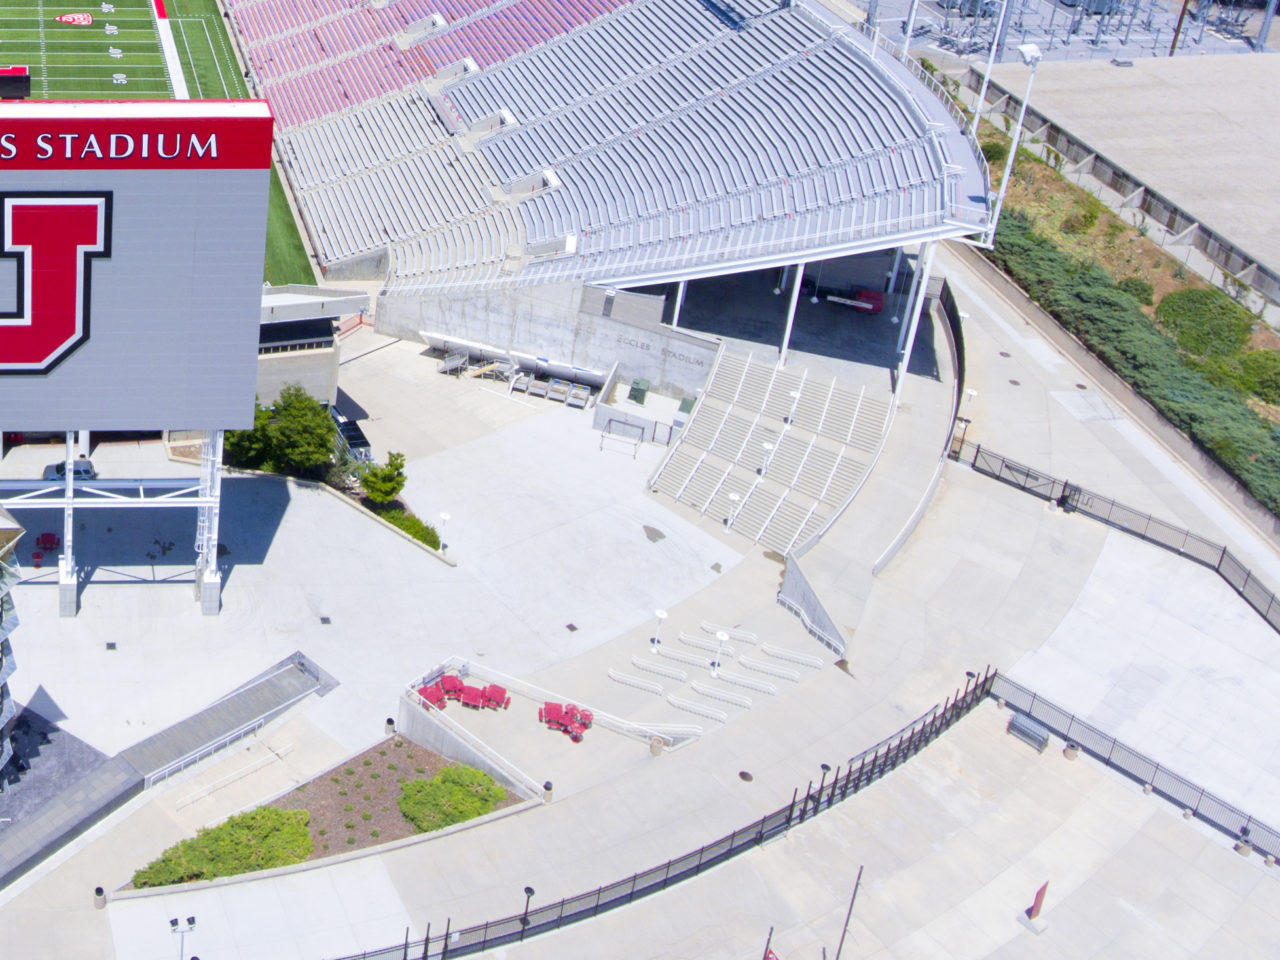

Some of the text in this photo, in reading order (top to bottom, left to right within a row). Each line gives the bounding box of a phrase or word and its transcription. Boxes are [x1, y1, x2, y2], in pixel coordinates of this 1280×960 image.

[101, 3, 115, 13] 20
[105, 25, 119, 35] 30
[109, 48, 124, 58] 40
[112, 73, 127, 84] 50
[36, 133, 219, 159] STADIUM
[617, 335, 651, 351] ECCLES
[661, 347, 705, 368] STADIUM
